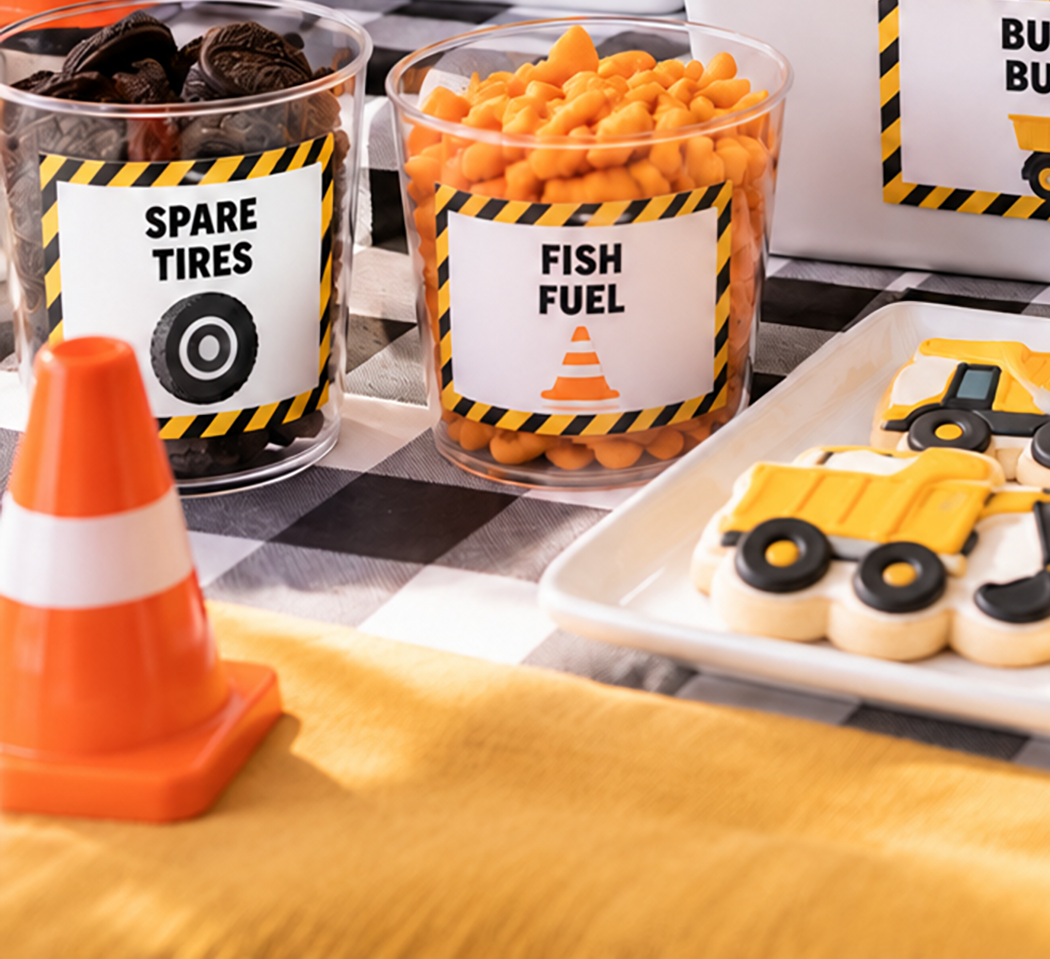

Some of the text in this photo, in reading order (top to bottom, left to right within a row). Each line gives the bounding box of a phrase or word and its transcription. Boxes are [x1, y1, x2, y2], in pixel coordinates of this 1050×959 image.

[145, 196, 258, 239] SPARE
[152, 241, 253, 282] TIRES
[541, 242, 622, 276] FISH
[539, 283, 625, 316] FUEL
